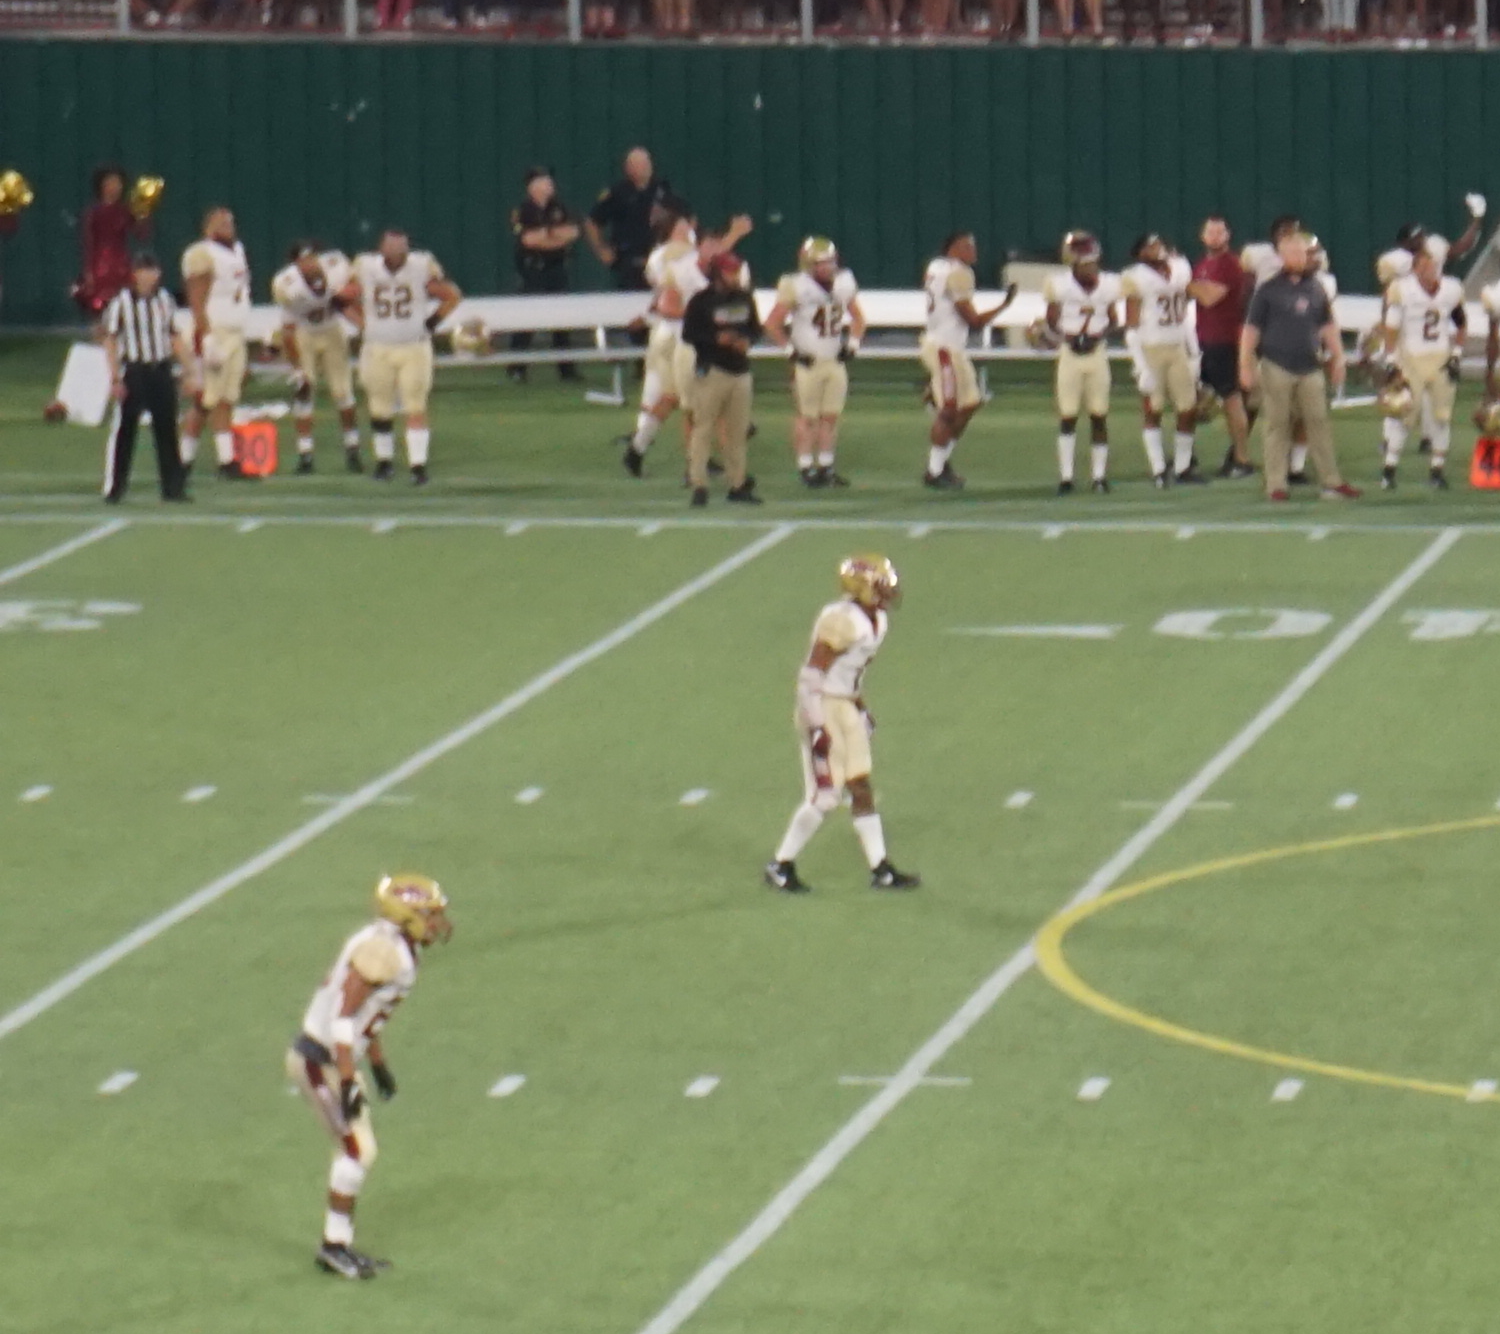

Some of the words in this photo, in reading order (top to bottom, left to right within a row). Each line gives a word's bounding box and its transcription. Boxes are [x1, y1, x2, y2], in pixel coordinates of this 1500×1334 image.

[375, 284, 412, 318] 52
[1158, 293, 1187, 326] 30
[813, 304, 843, 337] 42
[1080, 306, 1095, 335] 7
[1423, 309, 1440, 341] 2
